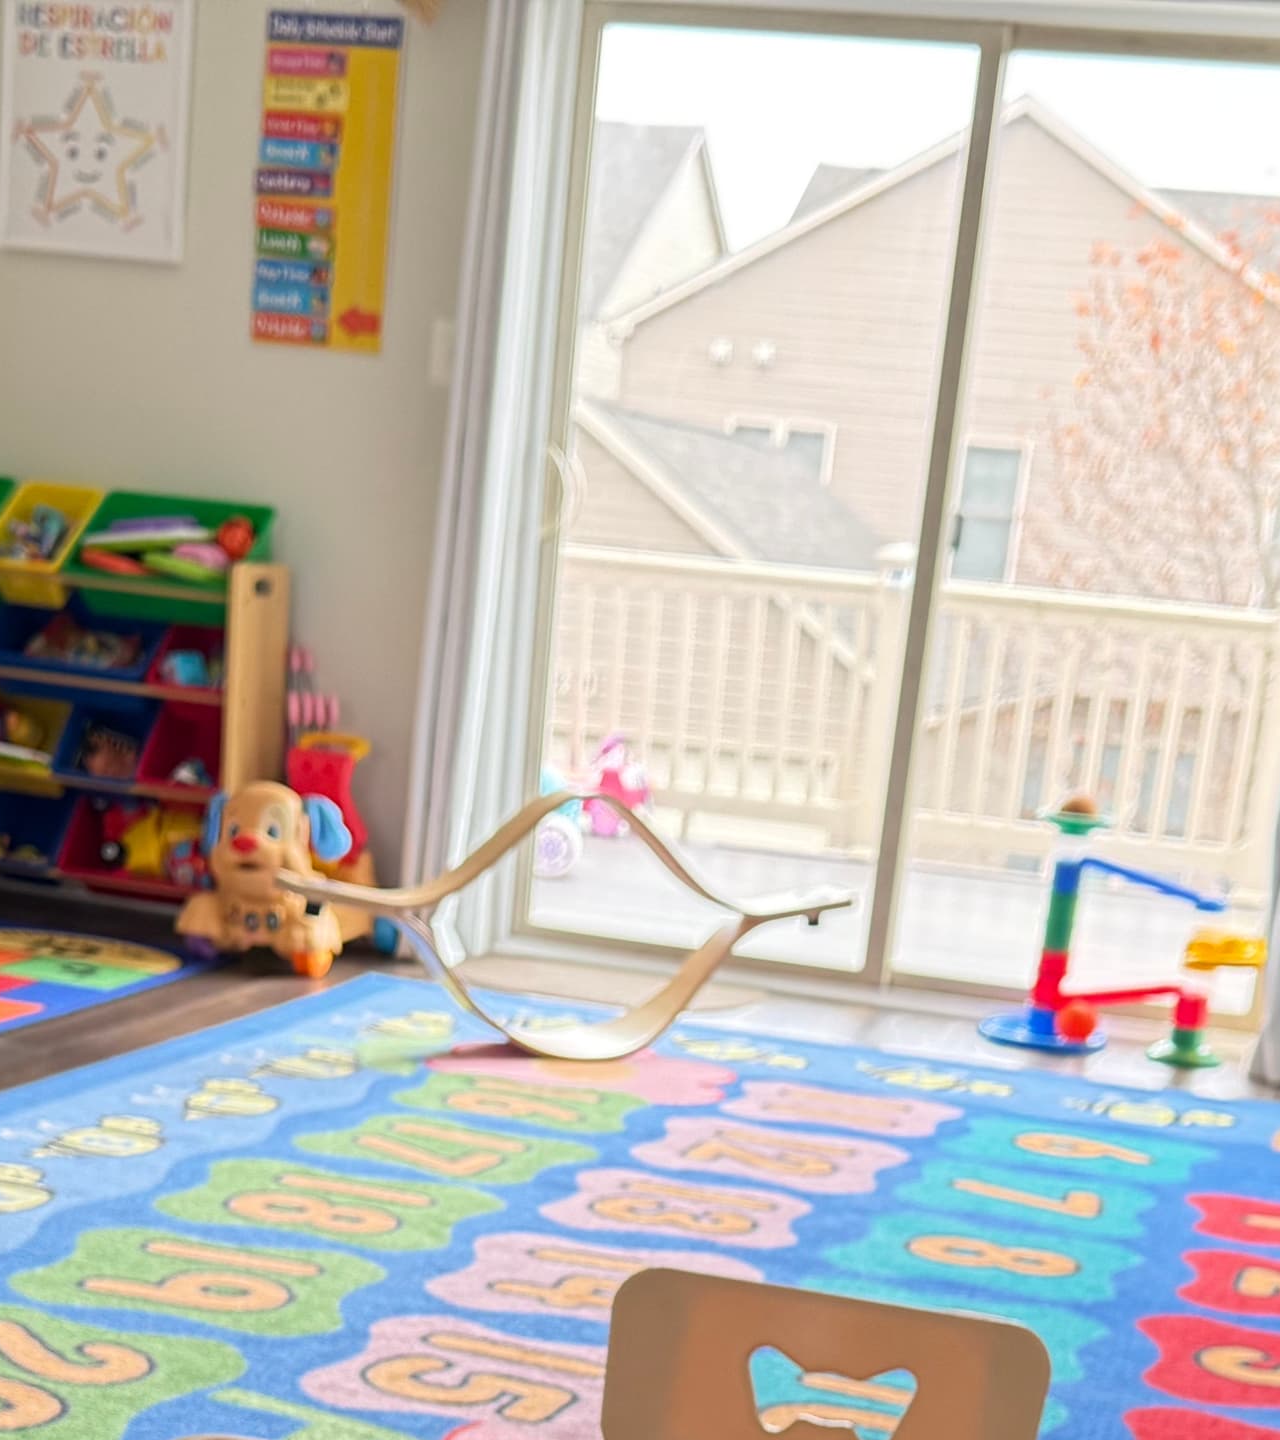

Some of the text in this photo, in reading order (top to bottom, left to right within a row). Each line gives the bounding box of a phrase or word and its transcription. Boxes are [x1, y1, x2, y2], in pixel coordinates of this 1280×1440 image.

[354, 1122, 532, 1177] 17
[680, 1129, 857, 1177] 12
[1014, 1131, 1153, 1166] 6
[225, 1174, 437, 1236] 18
[588, 1182, 779, 1236] 13
[950, 1178, 1103, 1219] 7
[78, 1239, 324, 1312] 19
[905, 1234, 1082, 1278] 8
[359, 1330, 606, 1424] 15
